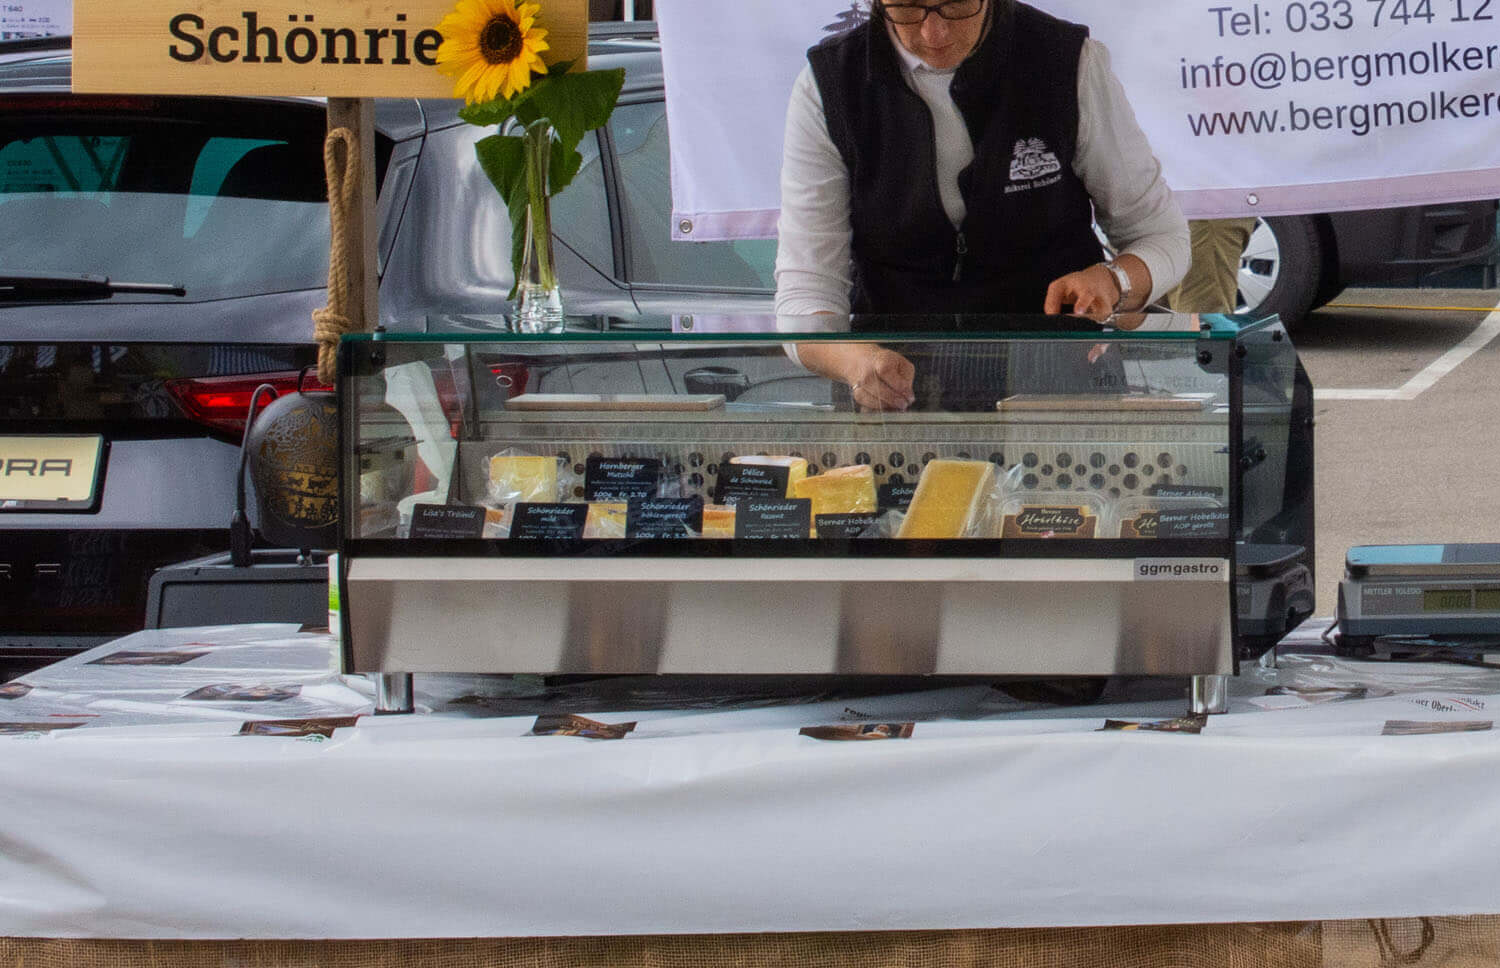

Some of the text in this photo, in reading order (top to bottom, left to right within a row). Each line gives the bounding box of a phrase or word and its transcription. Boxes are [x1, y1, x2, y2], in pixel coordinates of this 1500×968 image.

[1207, 3, 1271, 37] Tel:
[1285, 0, 1354, 33] 033
[168, 11, 445, 65] Schönrie
[0, 458, 73, 477] RA
